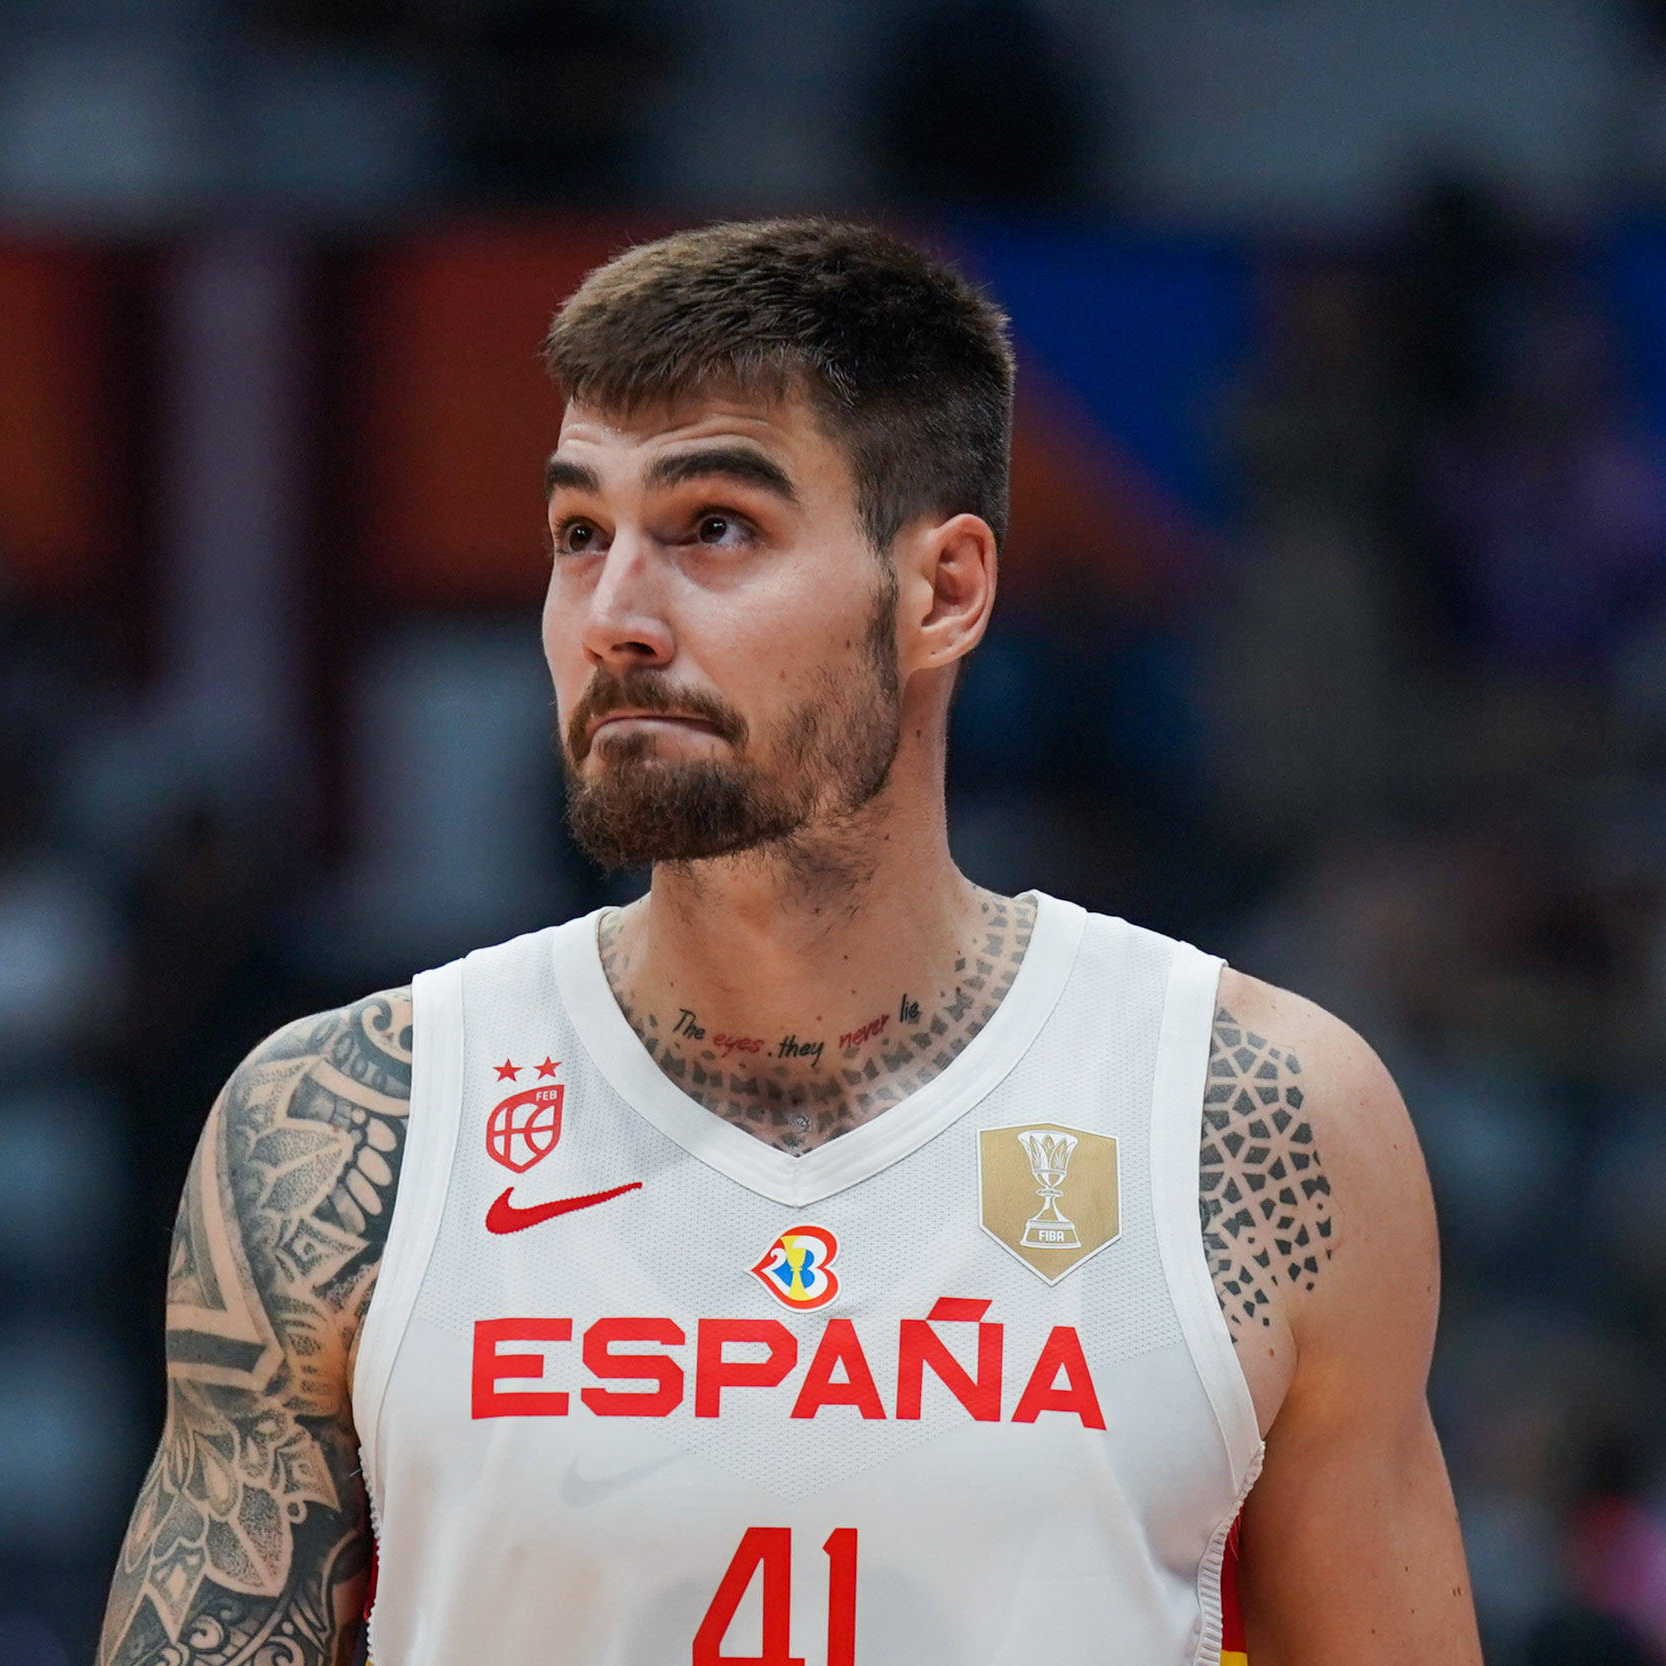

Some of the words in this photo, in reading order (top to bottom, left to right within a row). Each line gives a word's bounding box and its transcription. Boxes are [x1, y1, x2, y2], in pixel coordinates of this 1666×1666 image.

[672, 1008, 706, 1040] The
[778, 1034, 824, 1068] they
[839, 1013, 890, 1048] never
[899, 993, 920, 1023] lie
[536, 1089, 558, 1101] FEB
[1038, 1230, 1065, 1242] FIBA
[471, 1297, 1107, 1431] ESPAÑA
